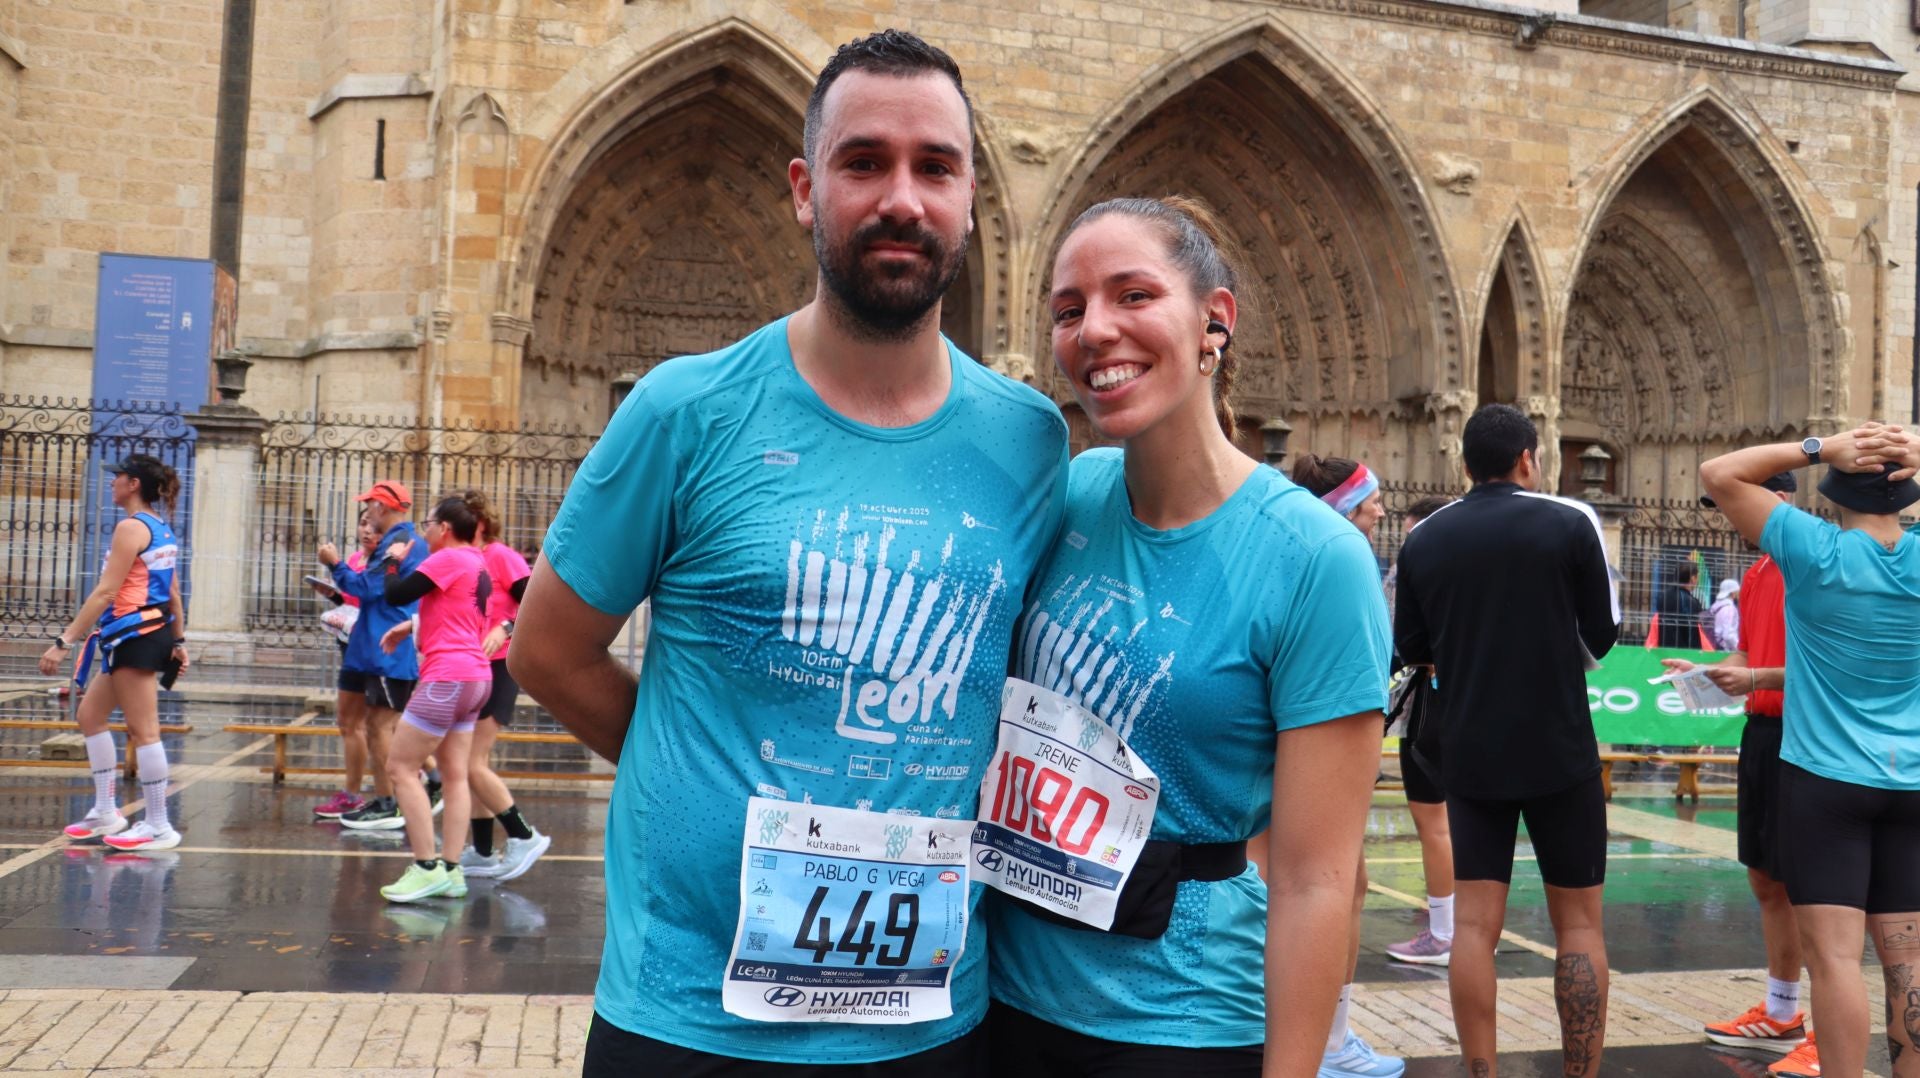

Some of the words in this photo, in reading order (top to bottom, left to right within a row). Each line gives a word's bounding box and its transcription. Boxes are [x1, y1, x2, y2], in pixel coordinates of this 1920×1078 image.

[801, 649, 843, 669] 10km
[769, 661, 841, 691] Hyundai
[1022, 713, 1058, 733] kutxabank
[1035, 741, 1081, 774] IRENE
[990, 750, 1110, 856] 1090
[758, 808, 789, 824] KAM
[809, 817, 822, 838] k
[884, 824, 913, 838] KAM
[806, 838, 861, 853] kutxabank
[928, 830, 937, 849] k
[926, 850, 963, 860] kutxabank
[804, 861, 858, 882] PABLO
[867, 867, 878, 884] G
[888, 869, 926, 888] VEGA
[1006, 861, 1082, 903] HYUNDAI
[1005, 877, 1036, 896] Lemauto
[1035, 889, 1079, 912] Automoción
[793, 886, 920, 966] 449
[811, 990, 910, 1009] HYUNDAI
[807, 1006, 848, 1015] Lemauto
[850, 1006, 910, 1017] Automoción
